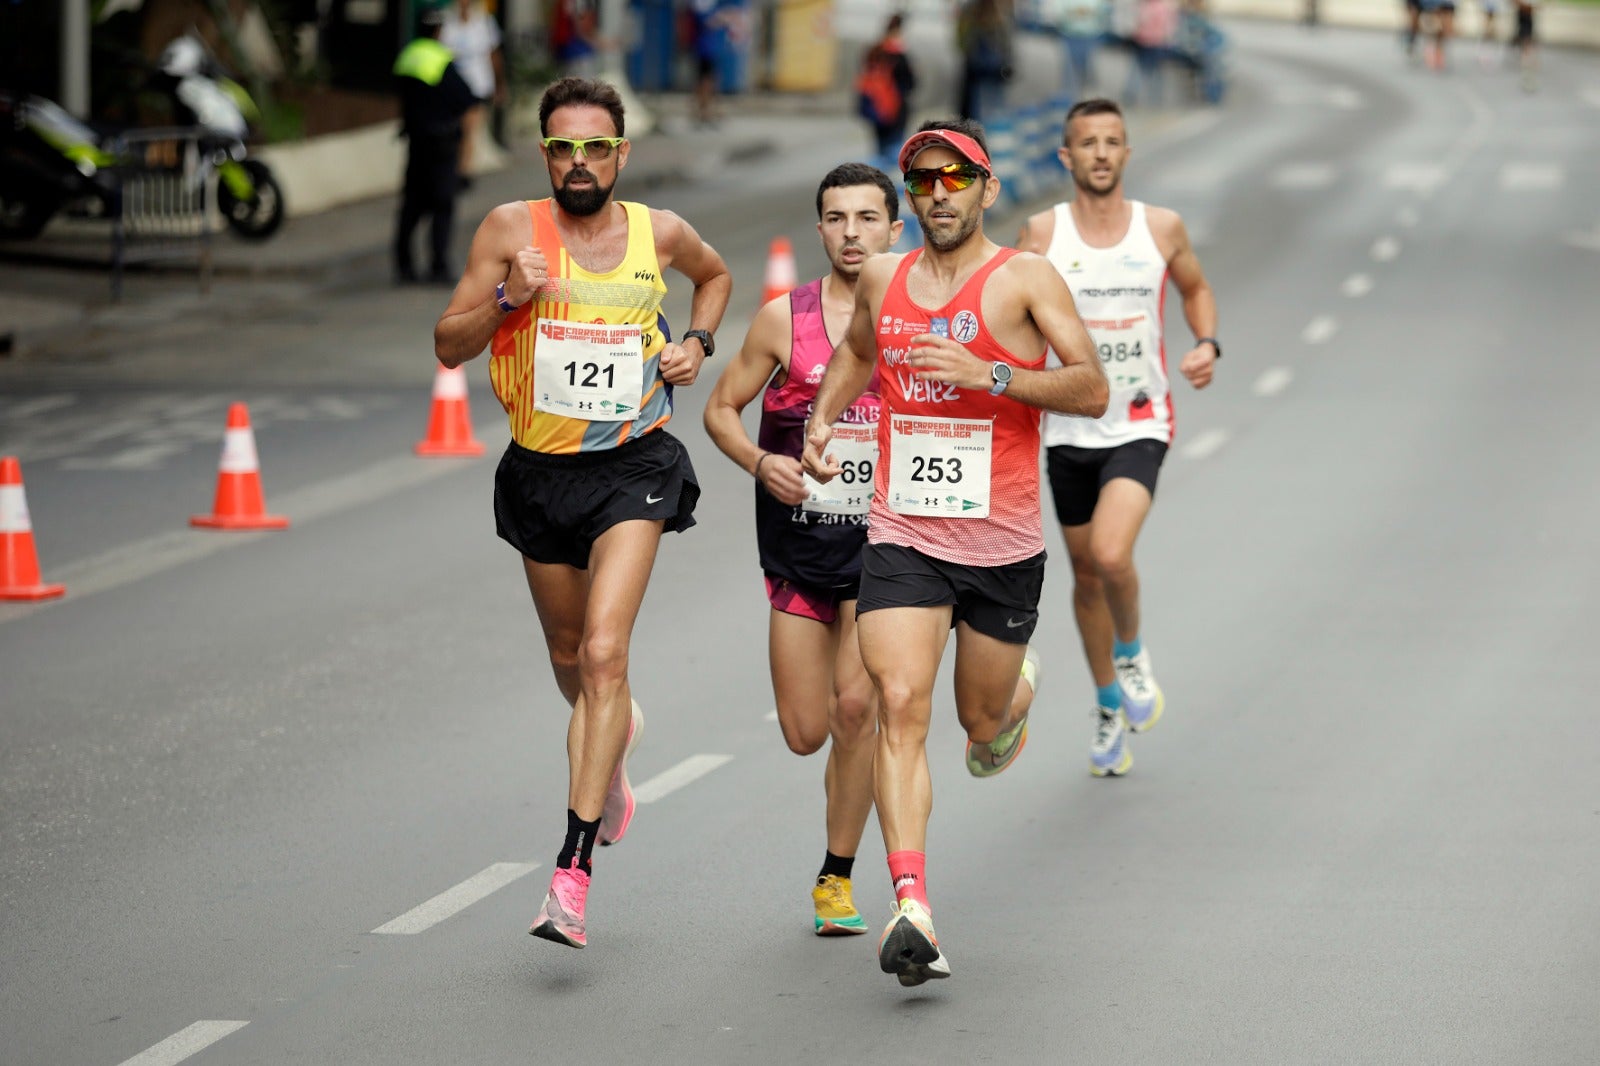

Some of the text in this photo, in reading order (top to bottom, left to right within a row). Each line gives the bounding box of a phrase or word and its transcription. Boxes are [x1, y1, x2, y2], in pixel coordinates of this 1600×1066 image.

[541, 324, 641, 340] 42 CARRERA URBANA
[564, 361, 615, 389] 121
[893, 420, 990, 435] 42 CARRERA URBANA
[840, 460, 873, 484] 69
[911, 456, 963, 484] 253
